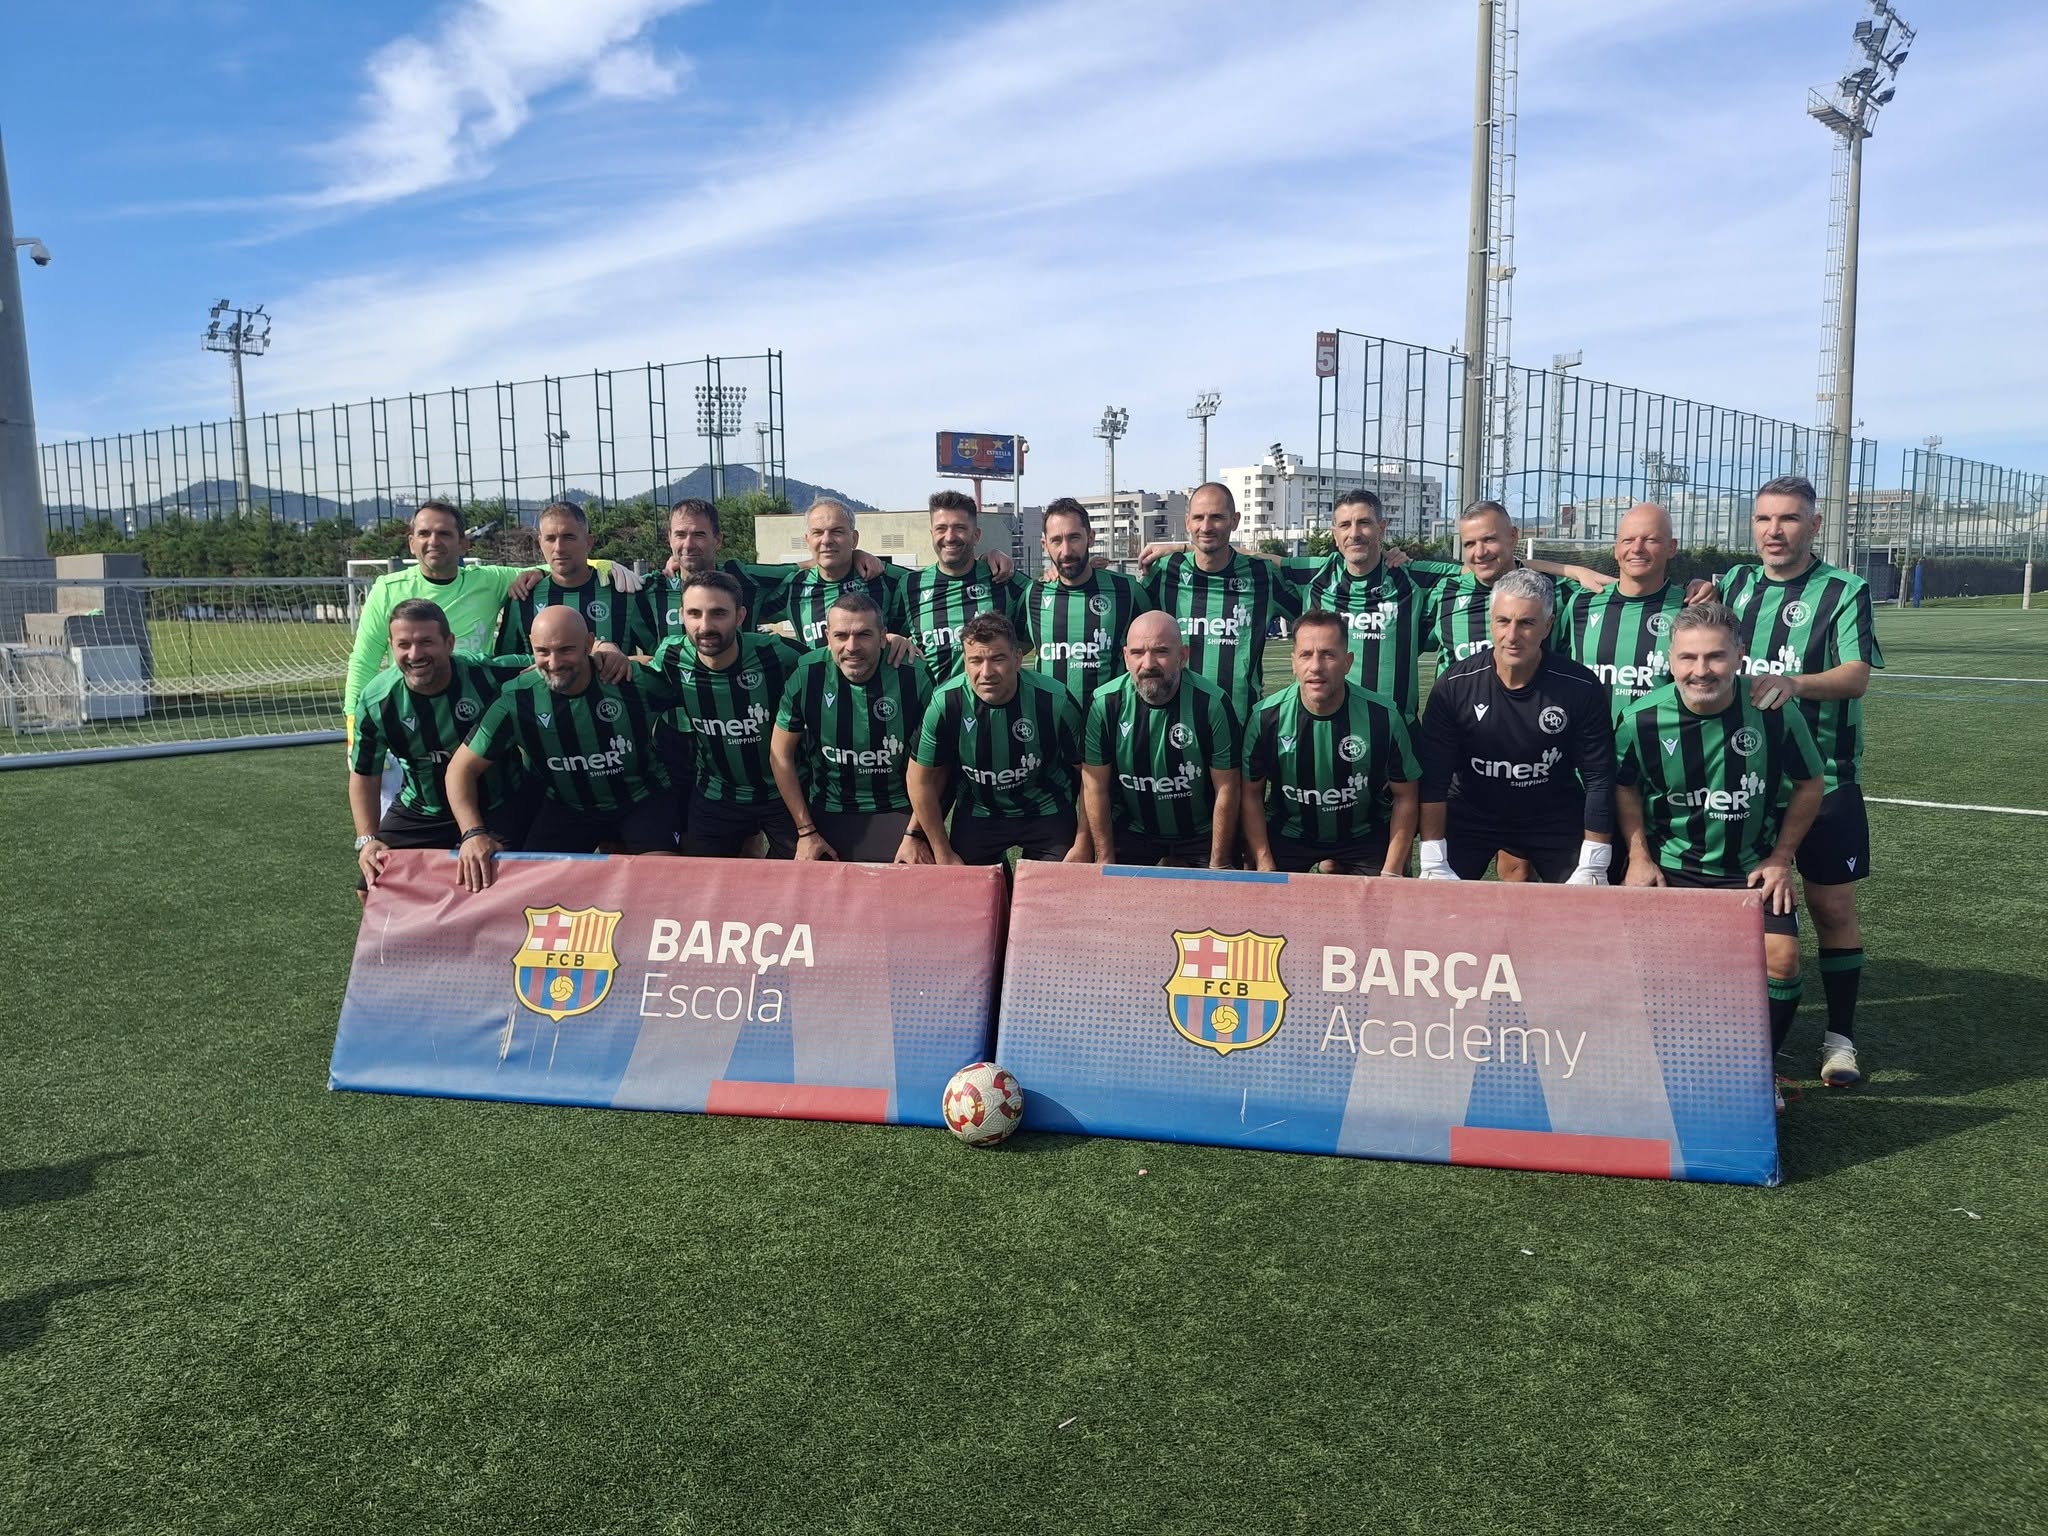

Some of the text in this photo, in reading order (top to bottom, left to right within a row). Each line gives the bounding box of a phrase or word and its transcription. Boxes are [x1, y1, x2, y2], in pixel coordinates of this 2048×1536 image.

[1317, 346, 1335, 372] 5
[1340, 612, 1386, 630] neR
[1207, 638, 1240, 646] SHIPPING
[1352, 632, 1387, 640] SHIPPING
[1068, 661, 1101, 669] SHIPPING
[1736, 655, 1786, 677] neR
[1586, 664, 1655, 687] ineR
[727, 735, 762, 745] SHIPPING
[858, 767, 893, 775] SHIPPING
[1510, 777, 1550, 788] SHIPPING
[1157, 791, 1193, 801] SHIPPING
[1321, 801, 1359, 812] SHIPPING
[1708, 811, 1751, 821] SHIPPING
[647, 918, 816, 975] BARÇA
[545, 952, 585, 967] FCB
[1322, 944, 1523, 1010] BARÇA
[1203, 980, 1249, 996] FCB
[639, 972, 784, 1023] Escola
[1319, 1004, 1588, 1079] Academy
